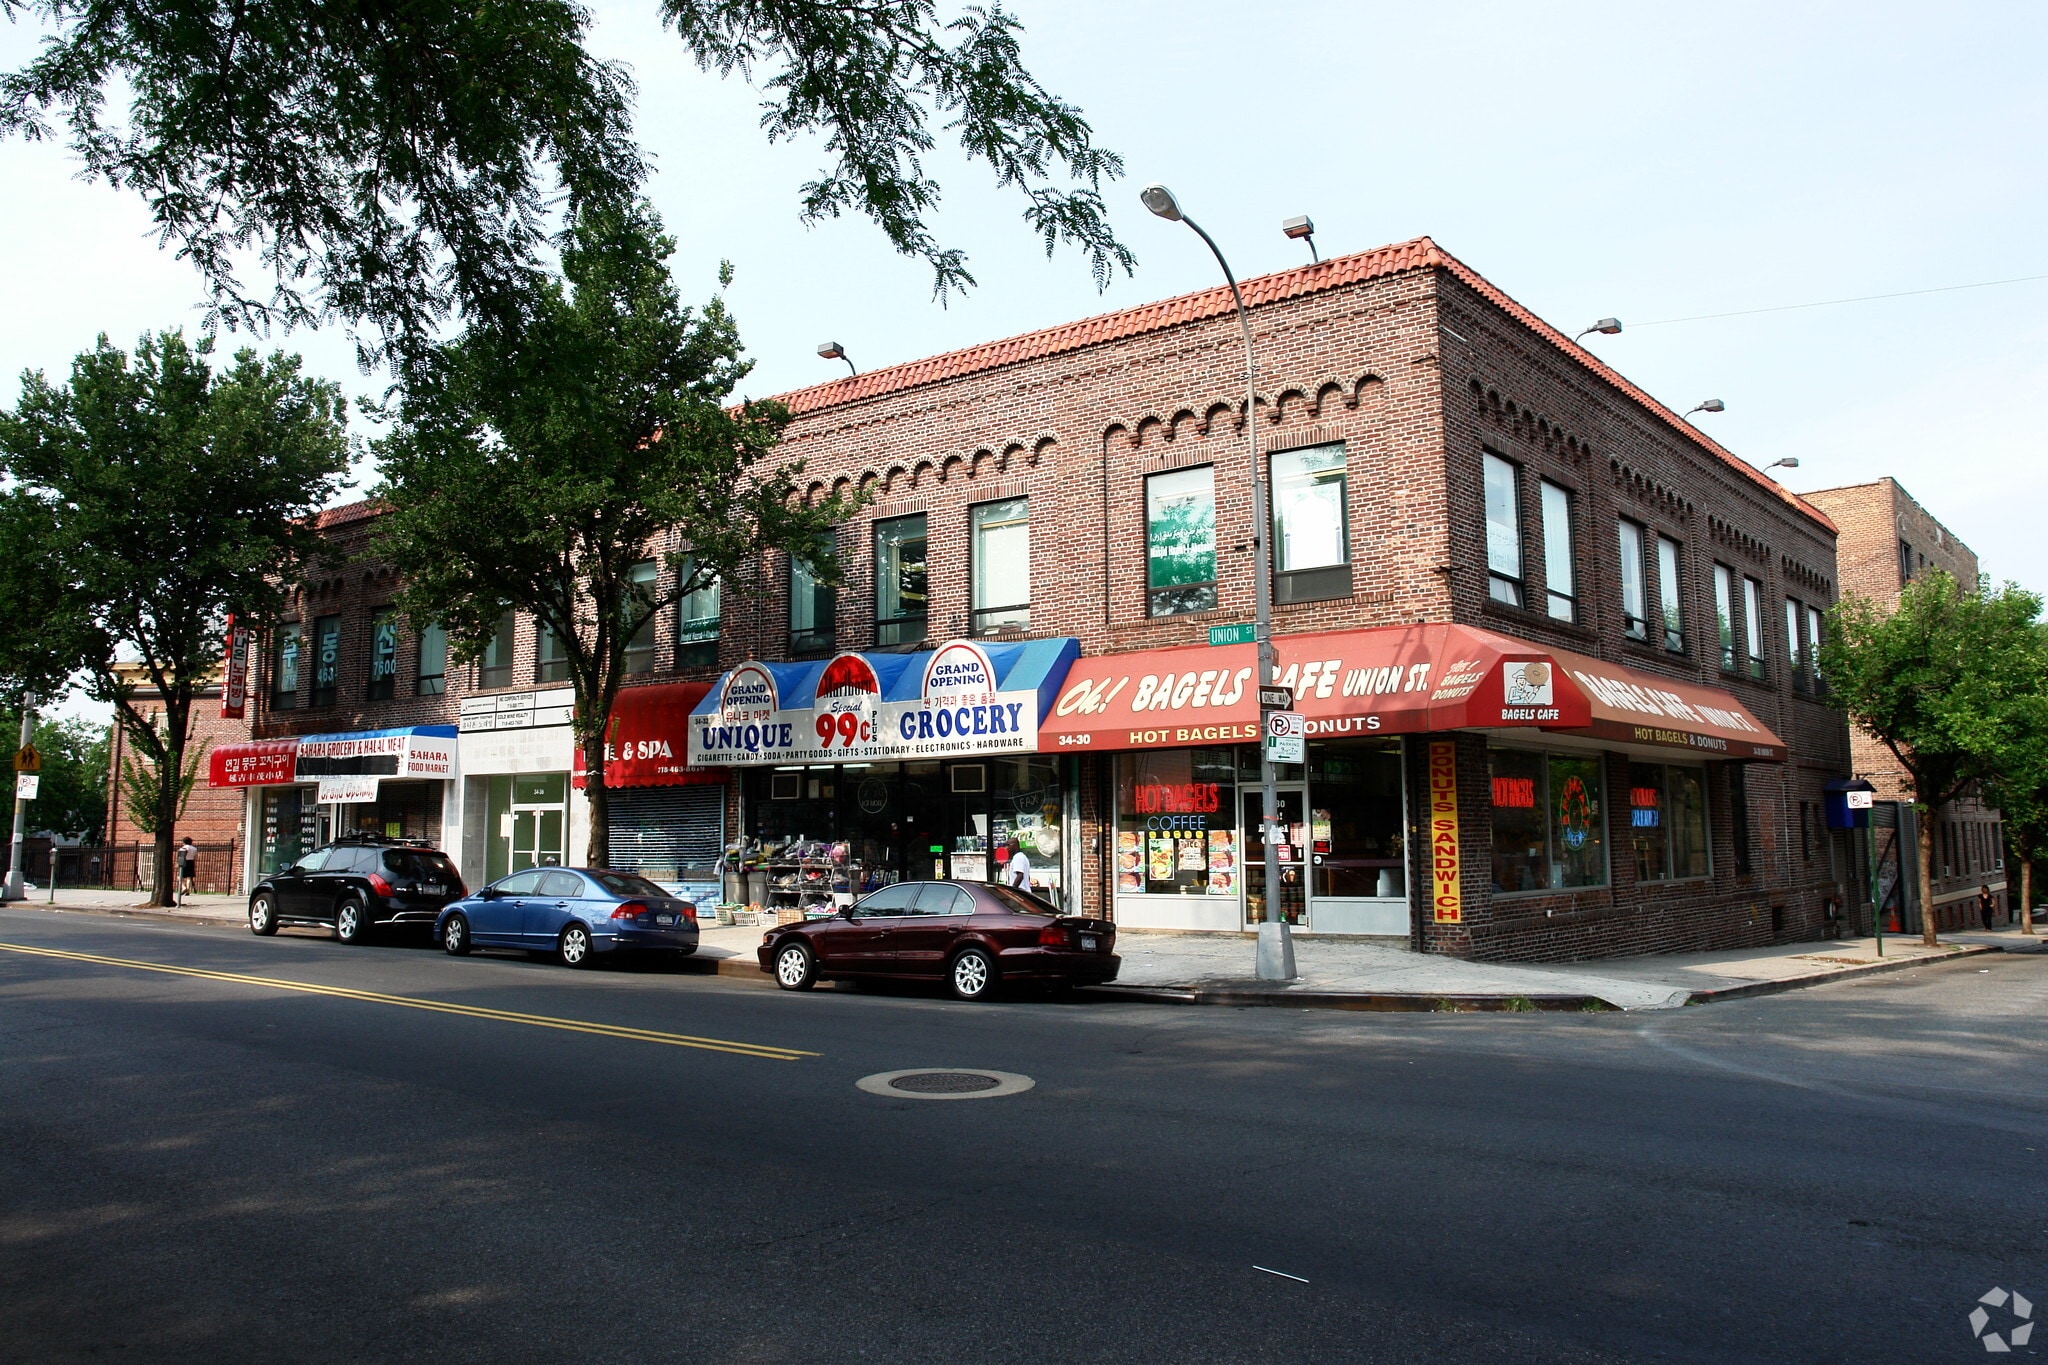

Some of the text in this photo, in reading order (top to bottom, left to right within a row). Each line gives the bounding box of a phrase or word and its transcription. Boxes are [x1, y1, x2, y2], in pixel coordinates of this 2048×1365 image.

[322, 632, 338, 663] 동
[377, 624, 396, 655] 산
[1211, 627, 1239, 644] UNION
[374, 659, 396, 676] 7600
[936, 662, 980, 676] GRAND
[930, 673, 985, 688] OPENING
[1440, 671, 1484, 687] BAGELS
[731, 684, 766, 695] GRAND
[1056, 659, 1432, 717] Oh! BAGELS AFE UNION ST.
[1431, 685, 1475, 701] DONUTS
[726, 694, 771, 706] OPENING
[1264, 692, 1288, 704] ONE WAY
[830, 700, 862, 715] Special
[1501, 708, 1560, 720] BAGELS CAFE
[726, 709, 770, 723] 유니크 마켓
[899, 702, 1023, 741] GROCERY
[702, 723, 793, 753] UNIQUE
[815, 712, 871, 749] 99¢
[1059, 734, 1091, 746] 34-30
[1129, 729, 1170, 744] HOT
[1176, 724, 1257, 741] BAGELS
[1301, 716, 1381, 734] ONUTS
[1634, 726, 1654, 741] HOT
[1655, 729, 1688, 745] BAGELS
[1689, 734, 1696, 745] &
[1697, 736, 1727, 751] DONUTS
[300, 742, 326, 757] SAHARA
[327, 741, 356, 756] GROCERY
[357, 741, 363, 754] &
[410, 750, 448, 762] SAHARA
[622, 741, 634, 761] &
[637, 739, 673, 760] SPA
[697, 737, 1023, 762] CIGARETTE CANDY SODA PARTY GOODS GIFTS STATIONARY ELECTRONICS HARDWARE
[407, 762, 449, 773] FOOD MARKET
[1019, 794, 1039, 808] FAX
[1135, 782, 1218, 814] HOT BAGELS
[1147, 815, 1206, 831] COFFEE
[1431, 745, 1458, 920] DONUTS SANDWICH
